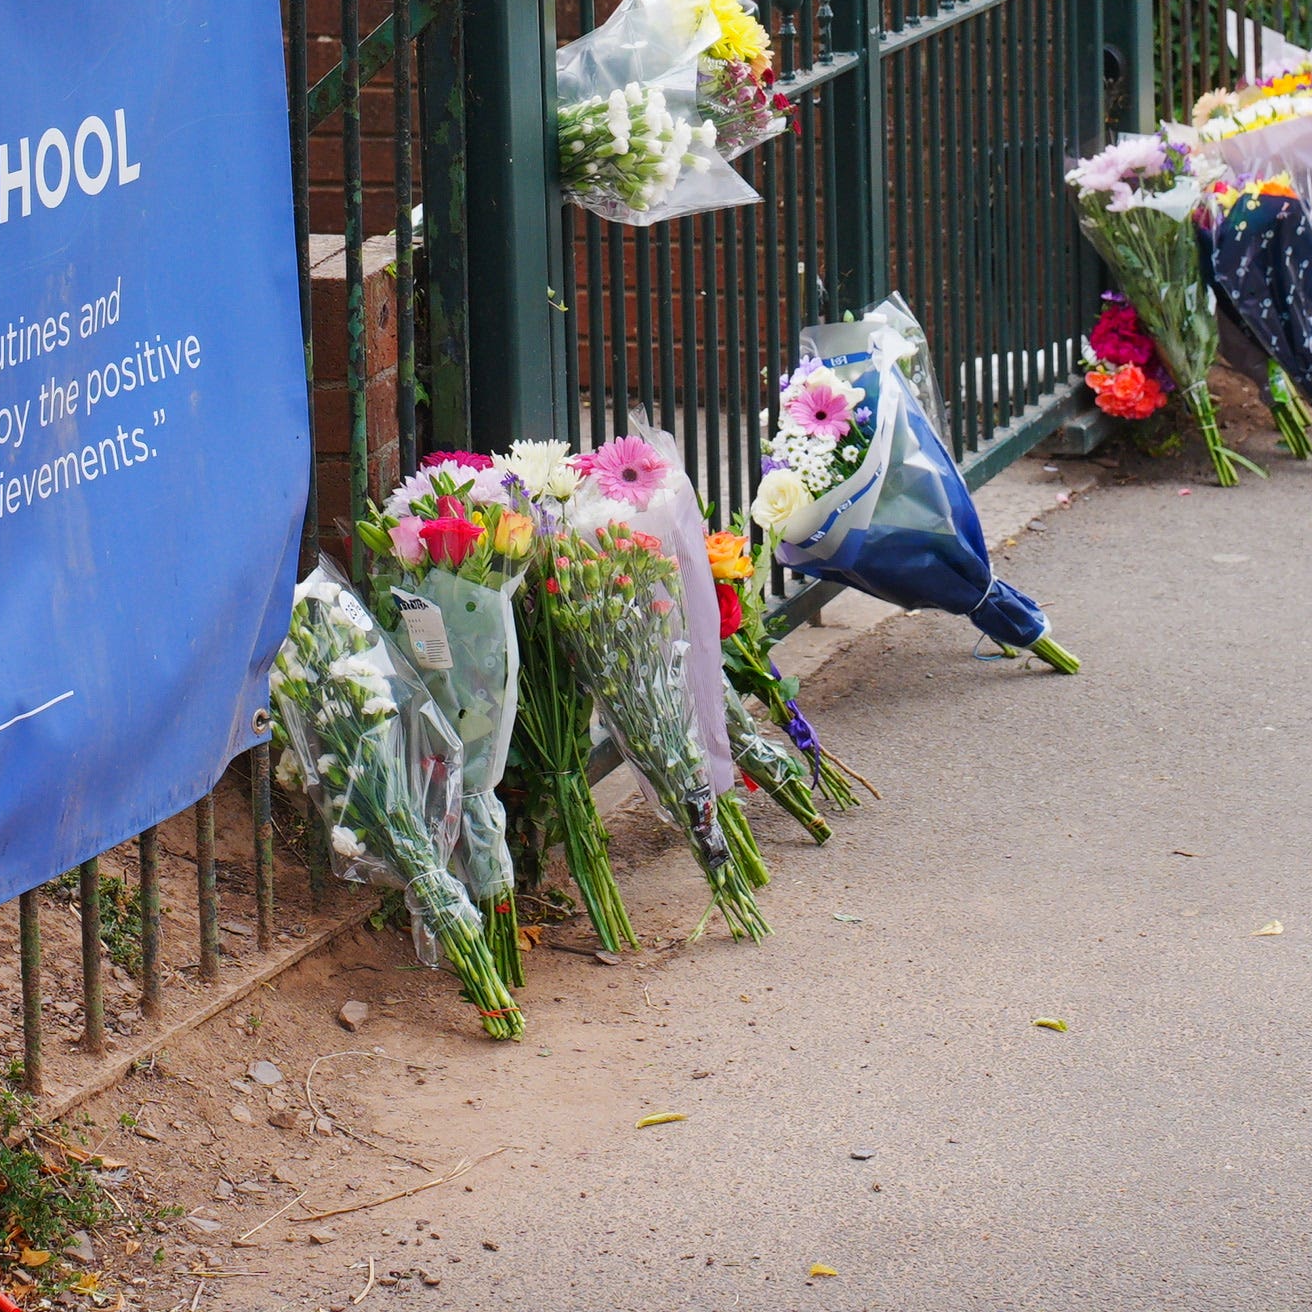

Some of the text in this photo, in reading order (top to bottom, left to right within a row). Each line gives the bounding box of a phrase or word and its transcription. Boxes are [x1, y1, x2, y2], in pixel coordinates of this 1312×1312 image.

[80, 276, 121, 338] and
[40, 377, 79, 427] the
[87, 335, 201, 415] positive
